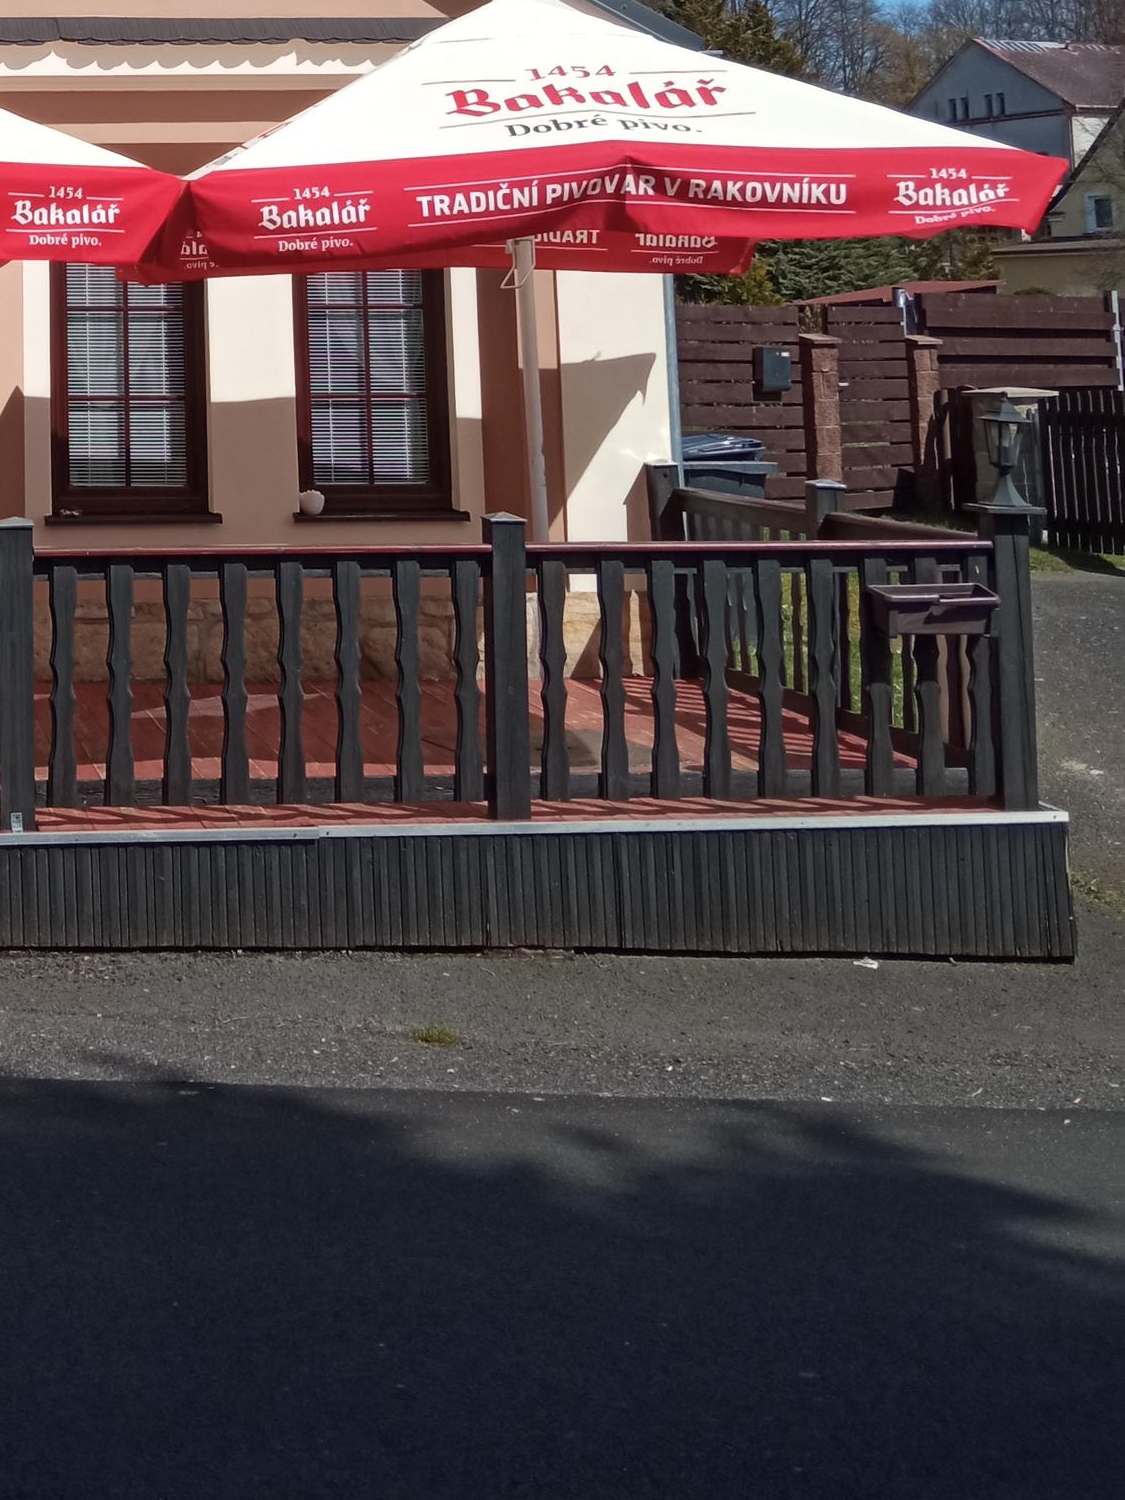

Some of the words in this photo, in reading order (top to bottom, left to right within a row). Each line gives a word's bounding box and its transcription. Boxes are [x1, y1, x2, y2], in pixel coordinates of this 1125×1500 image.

[525, 64, 616, 80] 1454
[445, 78, 727, 117] Bakalář
[506, 115, 608, 137] Dobré
[622, 117, 703, 133] pivo.
[930, 168, 967, 179] 1454
[49, 186, 83, 199] 1454
[293, 186, 331, 199] 1454
[417, 181, 538, 217] TRADIČNÍ
[546, 173, 655, 205] PIVOVAR
[664, 176, 682, 197] V
[688, 177, 847, 205] RAKOVNÍKU
[893, 182, 1011, 206] Bakalář
[11, 200, 121, 226] Bakalář
[259, 198, 371, 230] Bakalář
[915, 212, 957, 224] Dobré
[961, 205, 996, 217] pivo.
[29, 234, 68, 246] Dobré
[71, 235, 103, 248] pivo.
[278, 238, 318, 252] Dobré
[321, 236, 354, 251] pivo.
